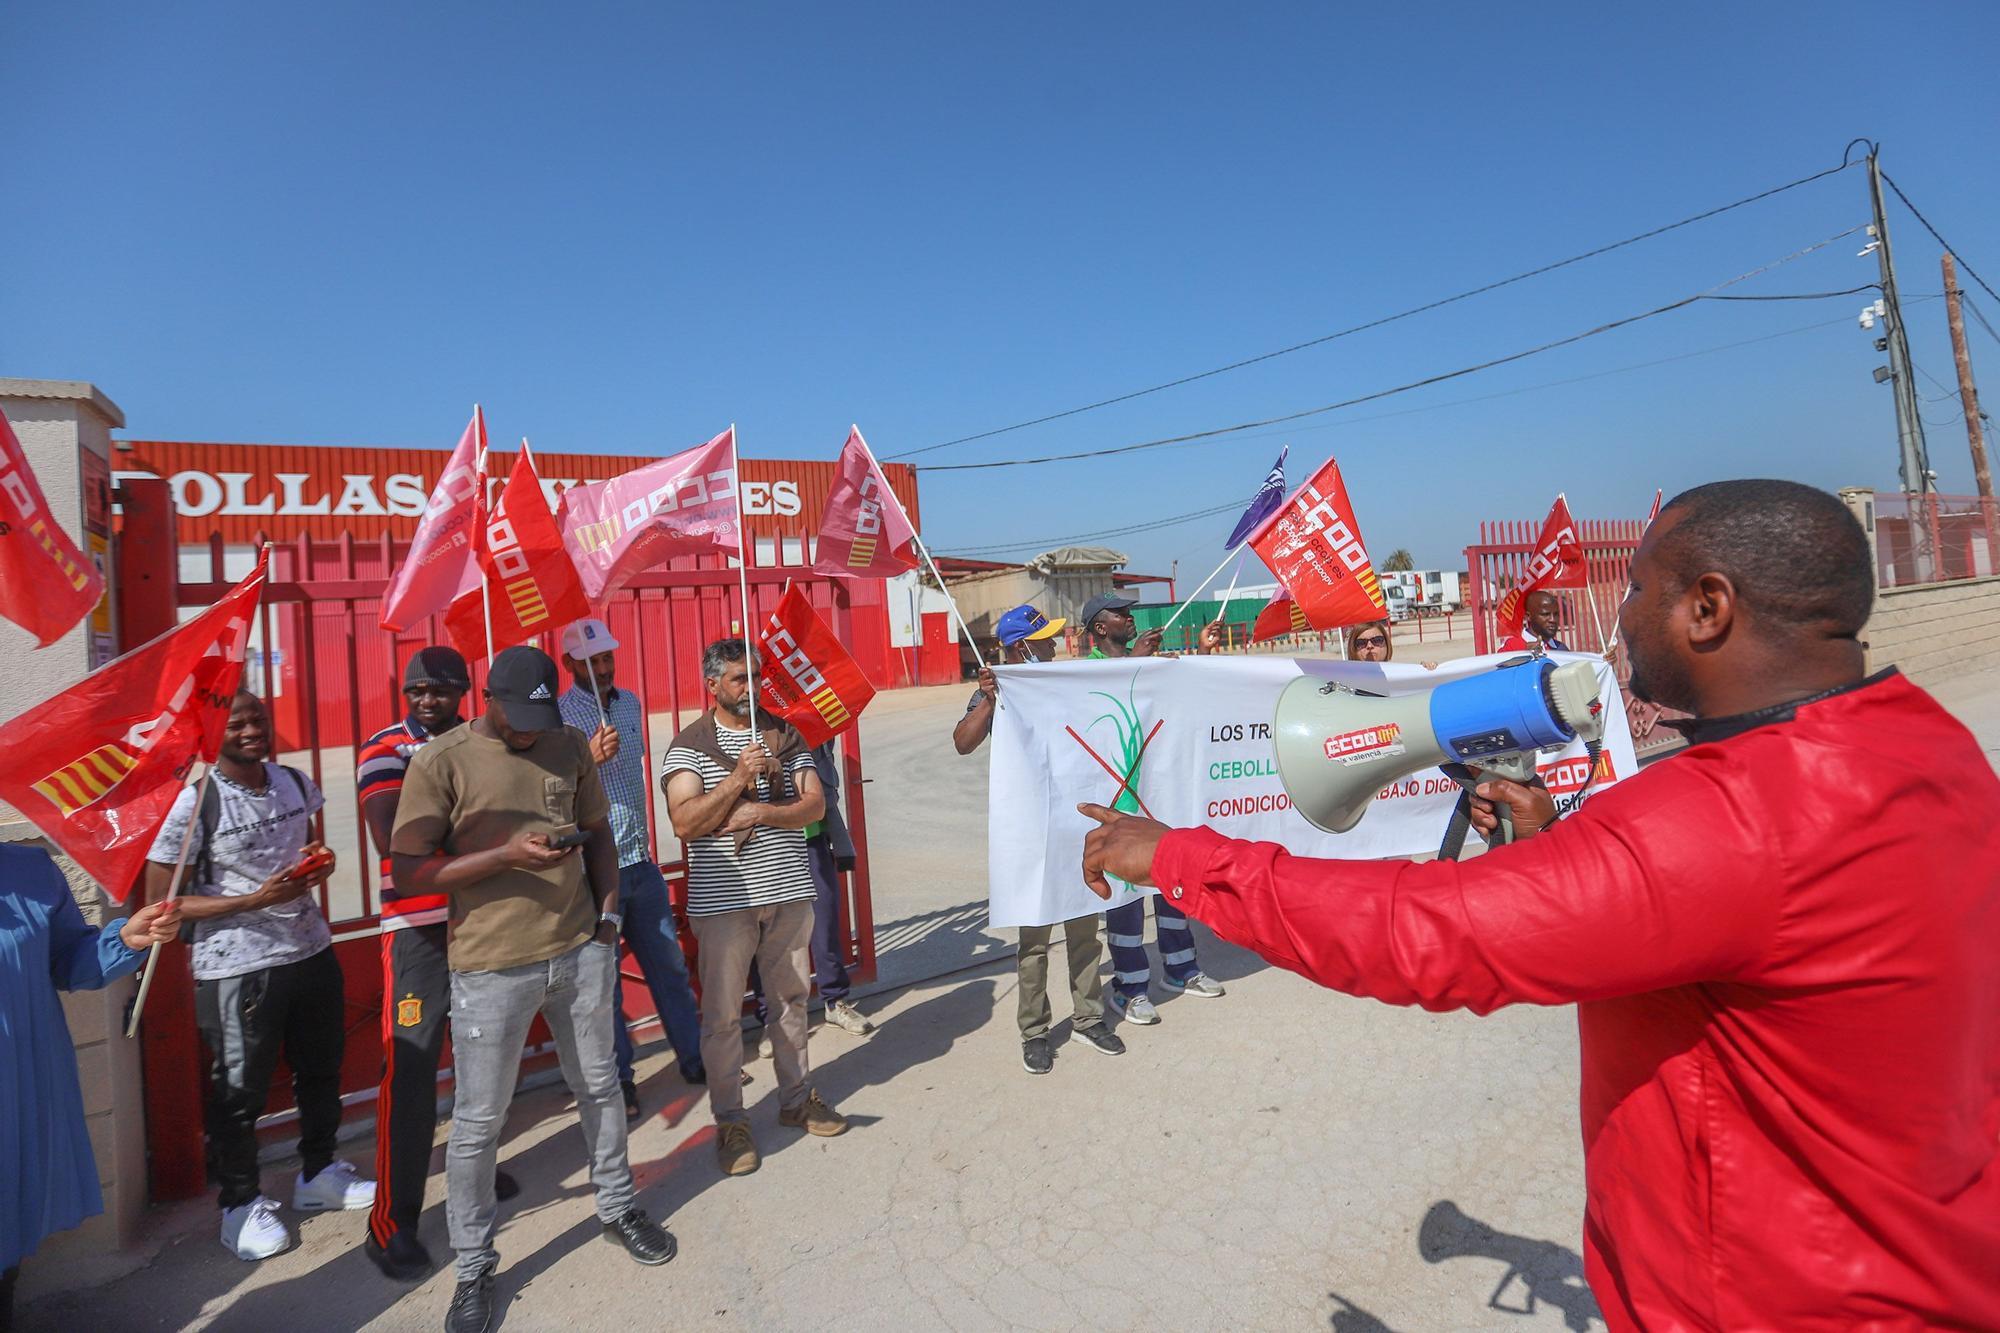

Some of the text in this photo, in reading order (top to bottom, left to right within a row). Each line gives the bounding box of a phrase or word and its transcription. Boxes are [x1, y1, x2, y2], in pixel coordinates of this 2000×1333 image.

[112, 470, 430, 517] OLLAS
[741, 480, 802, 517] ES
[1295, 483, 1369, 572] CCOO
[1311, 560, 1334, 586] ccoopv
[529, 692, 551, 700] adidas
[1211, 724, 1243, 743] LOS
[1326, 731, 1377, 755] CCOO
[1209, 758, 1278, 781] CEBOLL
[1537, 762, 1590, 789] COO
